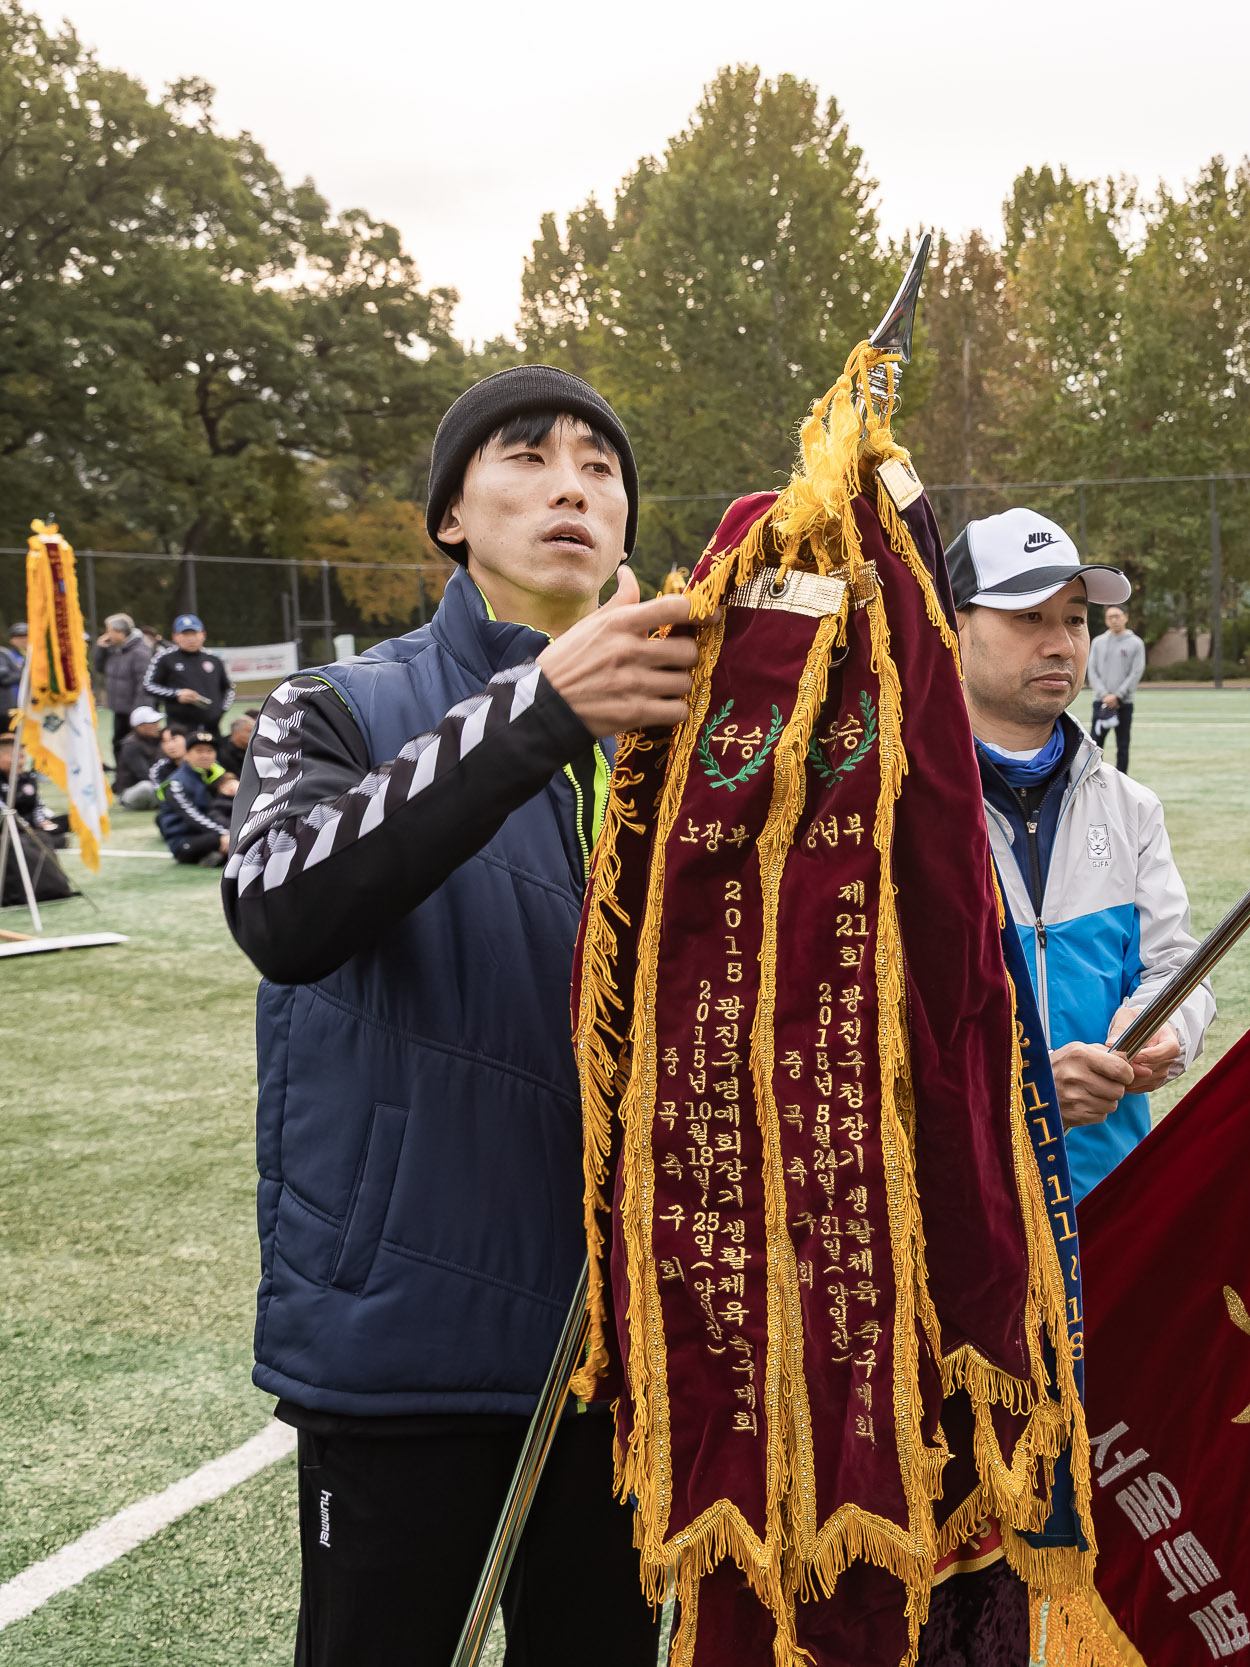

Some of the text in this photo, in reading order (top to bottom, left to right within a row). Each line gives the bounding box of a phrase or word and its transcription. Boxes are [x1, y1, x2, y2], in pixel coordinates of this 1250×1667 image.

[1028, 532, 1053, 545] NIKE
[711, 723, 764, 760] 우승
[818, 713, 864, 750] 우승
[679, 818, 751, 851] 노장부
[836, 985, 869, 1174] 광진구청장기
[717, 1219, 752, 1326] 생활체육
[844, 1185, 881, 1308] 생활체육
[853, 1319, 884, 1449] 축구대회
[319, 1489, 333, 1548] hummel
